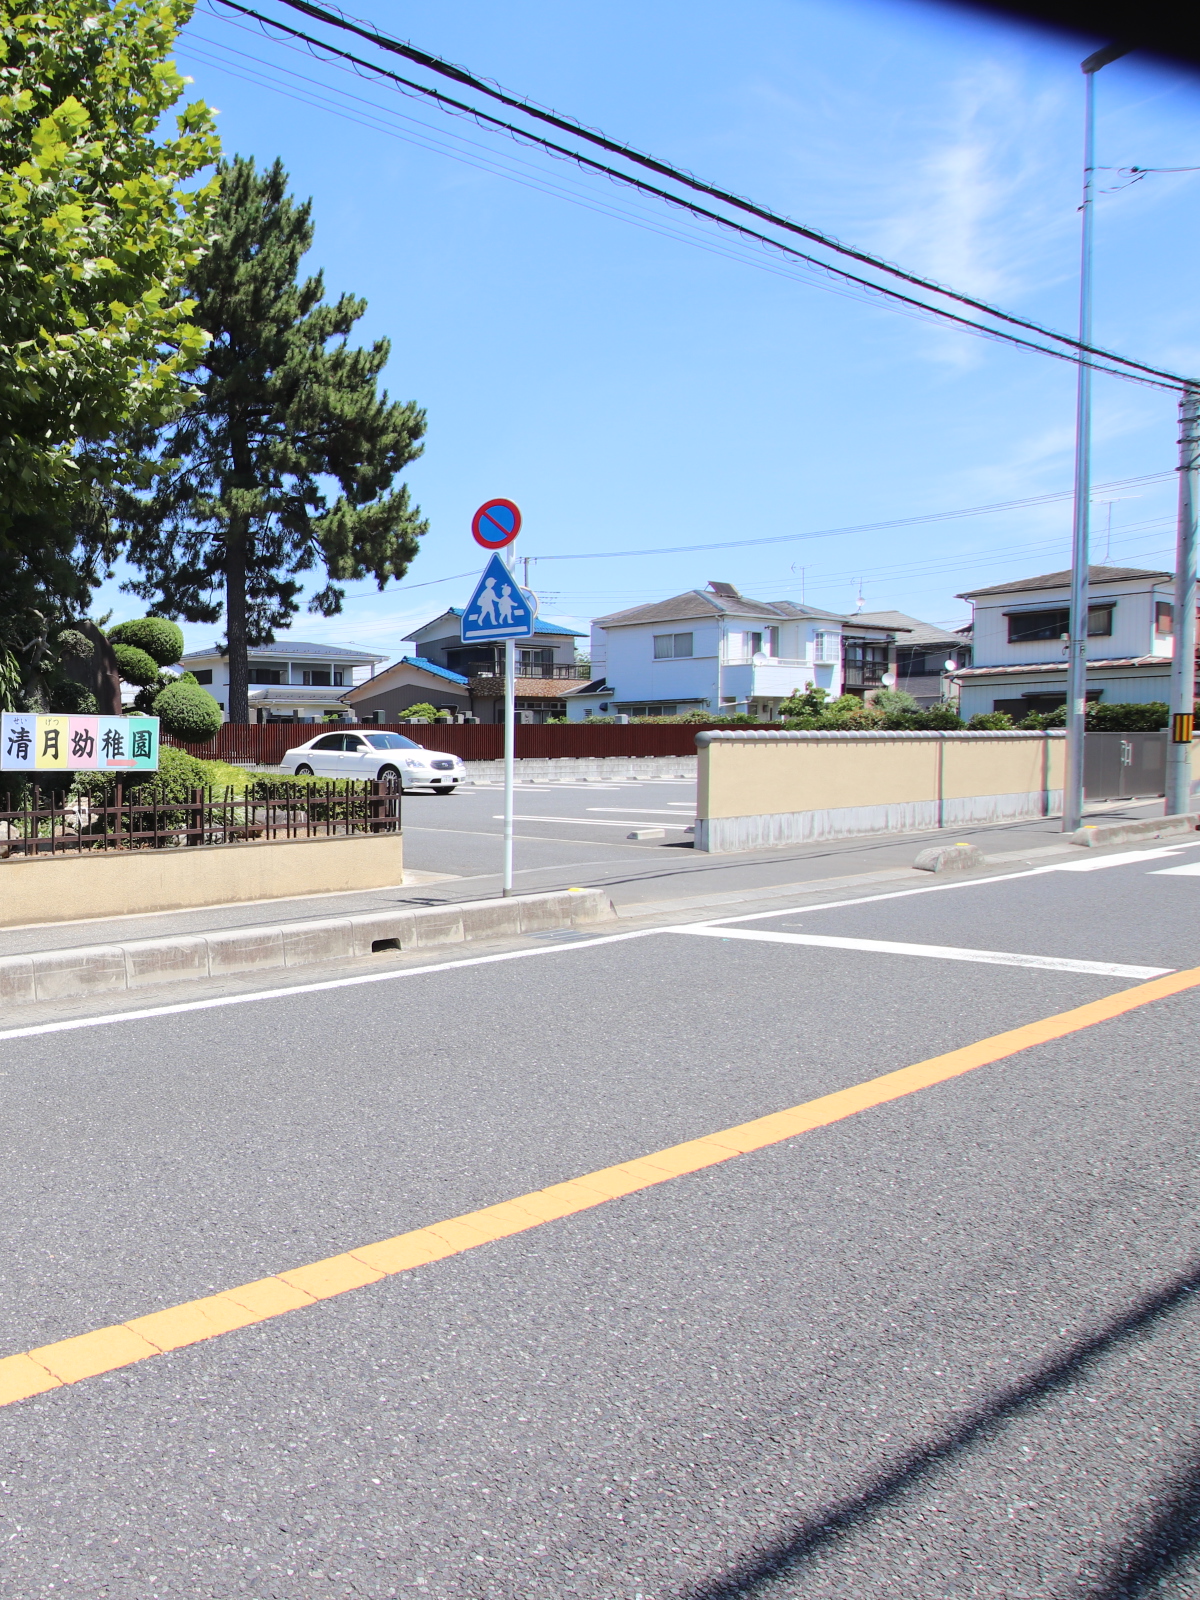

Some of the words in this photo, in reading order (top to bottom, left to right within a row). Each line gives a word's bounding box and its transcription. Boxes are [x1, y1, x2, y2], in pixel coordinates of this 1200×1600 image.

[13, 717, 27, 725] せい
[6, 727, 153, 760] 清月幼稚園
